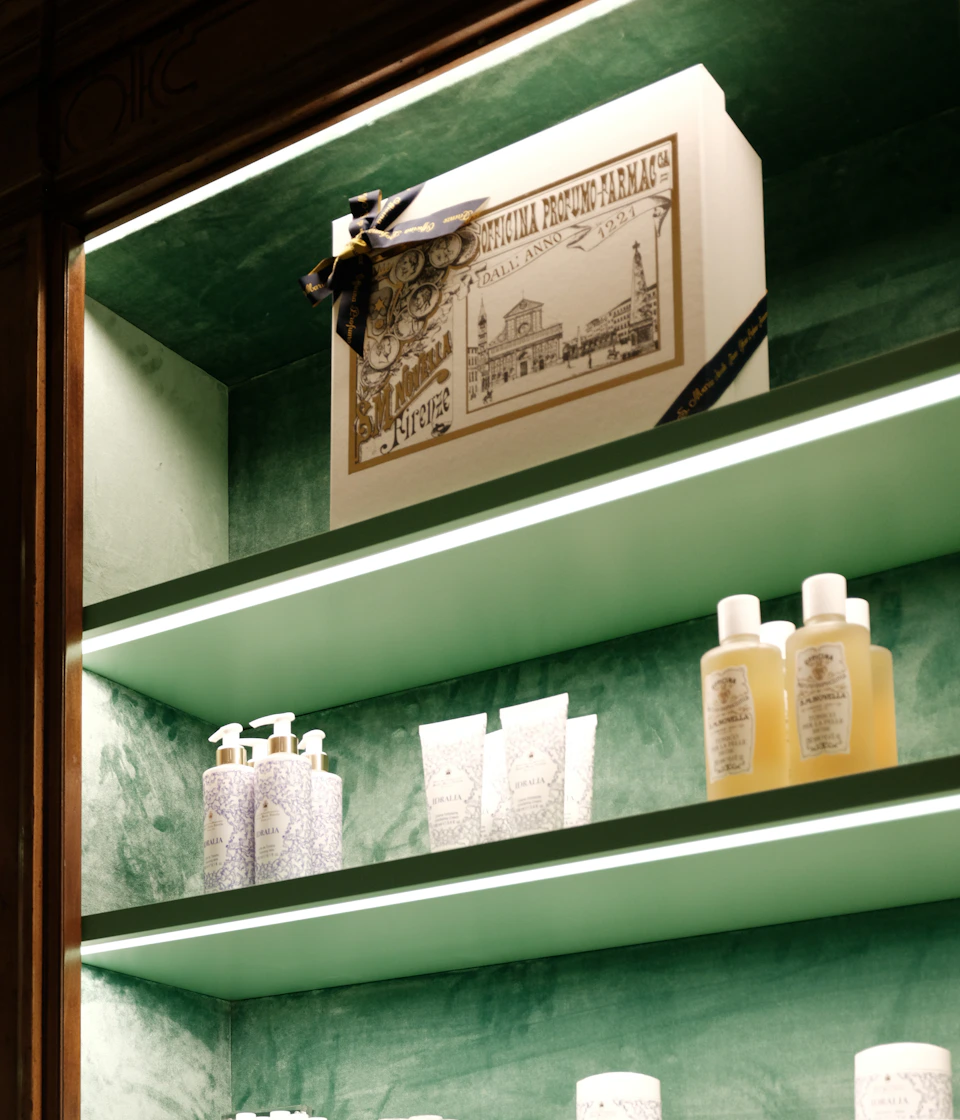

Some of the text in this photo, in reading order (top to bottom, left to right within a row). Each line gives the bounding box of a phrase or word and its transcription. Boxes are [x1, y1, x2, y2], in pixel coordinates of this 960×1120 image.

[480, 203, 540, 254] OFFICINA
[482, 206, 637, 286] DALL' ANNO 1221
[380, 387, 450, 454] Firenze
[432, 794, 462, 805] IDRALIA
[515, 776, 545, 789] IDRALIA
